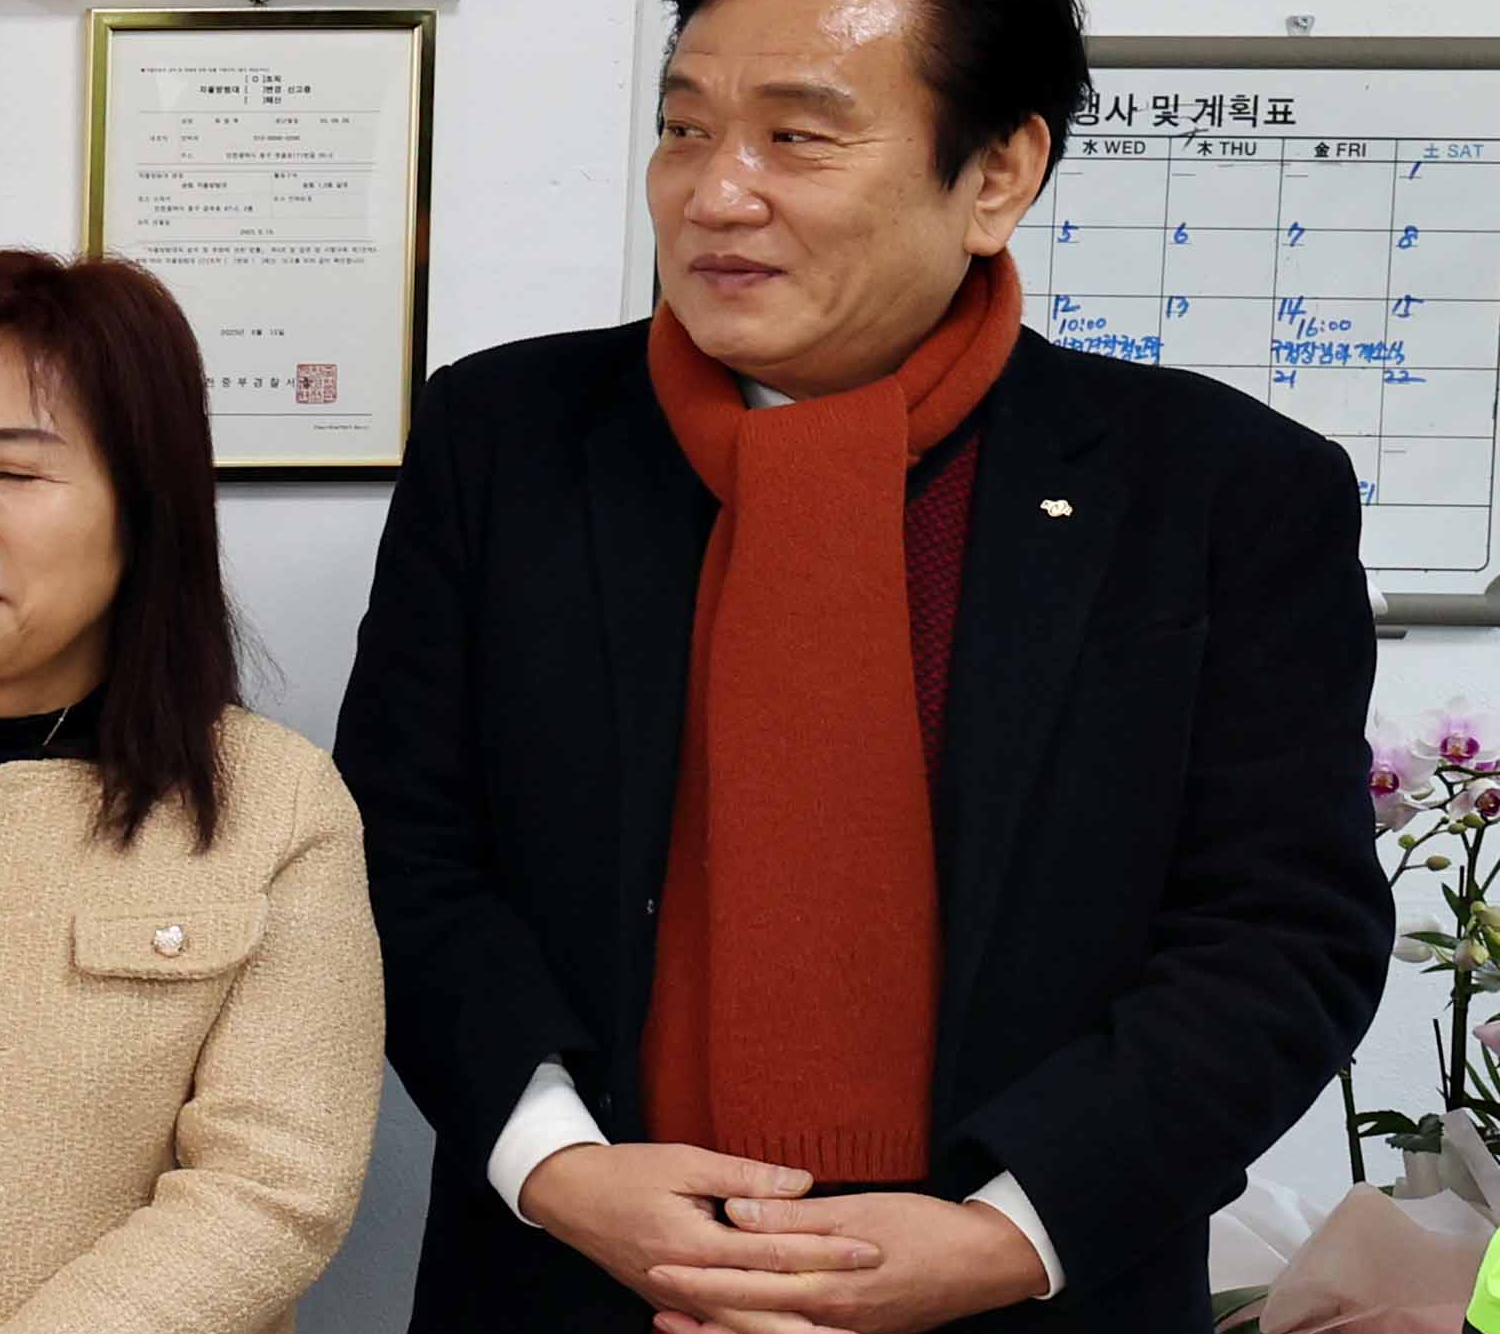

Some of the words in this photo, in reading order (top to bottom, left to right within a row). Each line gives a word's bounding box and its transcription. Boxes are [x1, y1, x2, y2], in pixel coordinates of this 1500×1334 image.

[1151, 95, 1180, 128] 및
[1194, 93, 1297, 127] 계획표
[1083, 138, 1098, 155] 水
[1104, 140, 1146, 155] WED
[1197, 139, 1212, 156] 木
[1219, 142, 1257, 156] THU
[1314, 141, 1330, 158] 金
[1336, 143, 1367, 158] FRI
[1423, 142, 1440, 159] 土
[1446, 144, 1484, 159] SAT
[1058, 221, 1079, 243] 5
[1174, 223, 1188, 244] 6
[1287, 222, 1305, 247] 7
[1397, 226, 1418, 249] 8
[1053, 295, 1081, 319] 12
[1166, 296, 1189, 318] 13
[1278, 297, 1306, 325] 14
[1392, 295, 1423, 318] 15
[1059, 318, 1107, 335] 10:00
[1300, 319, 1351, 338] 16:00
